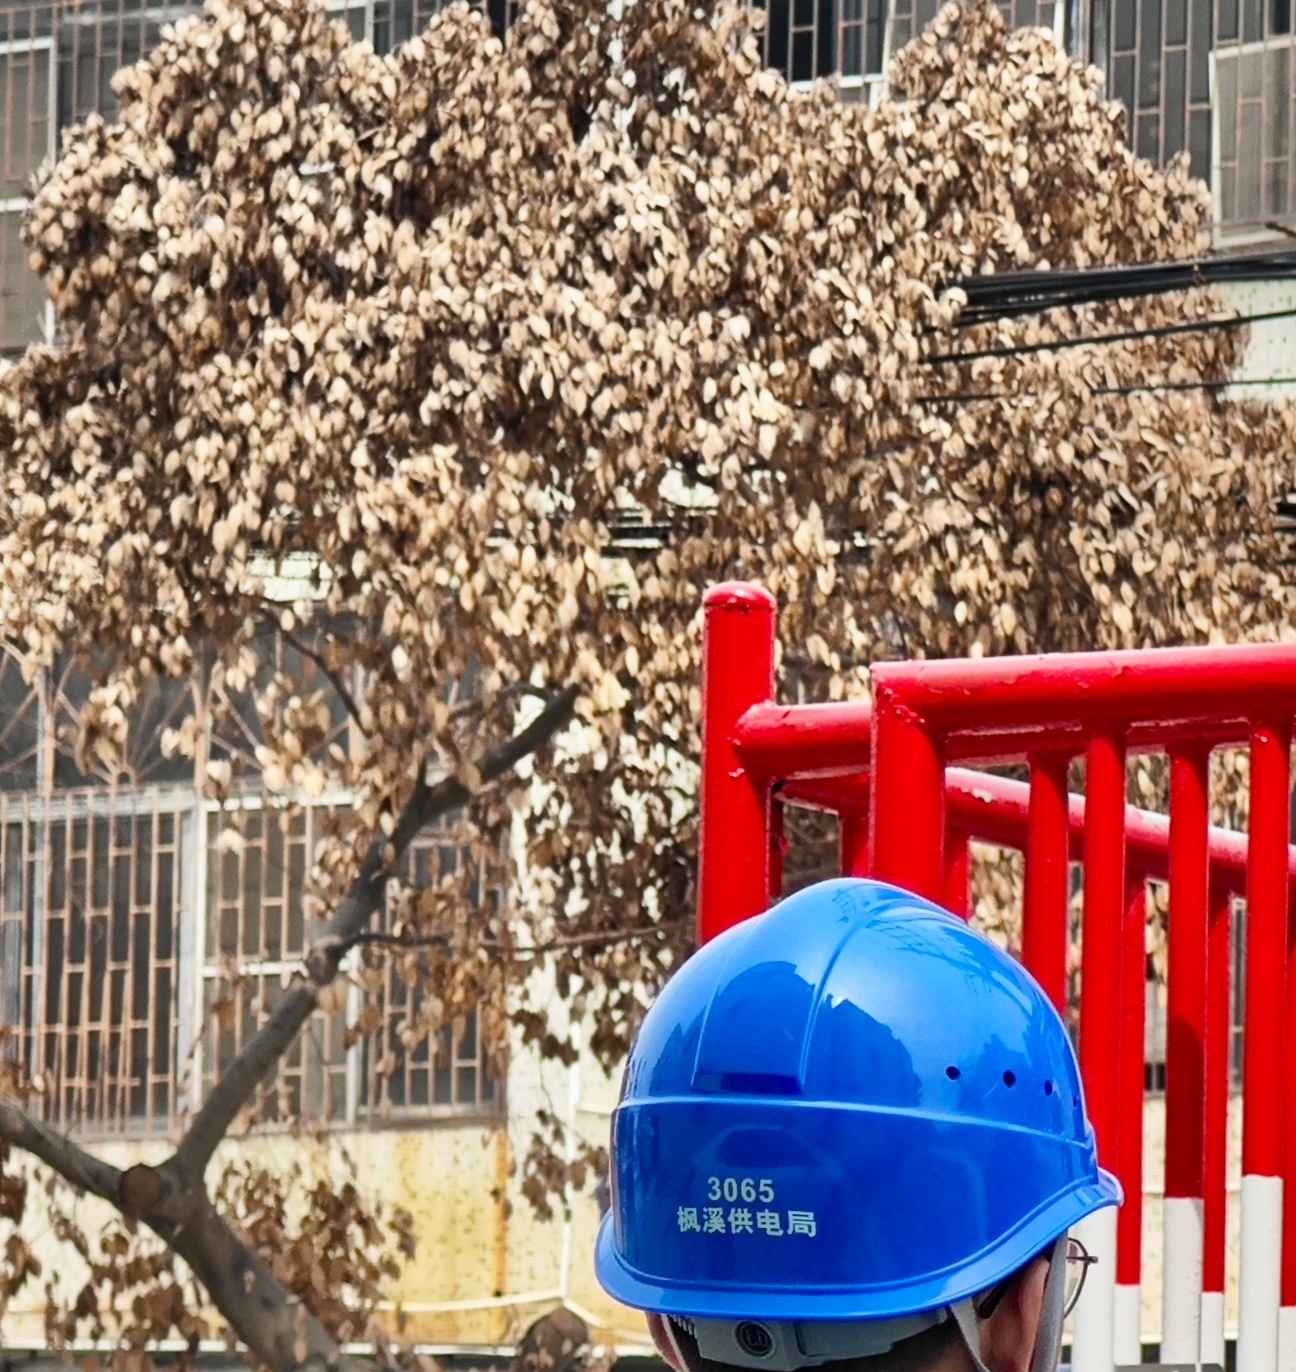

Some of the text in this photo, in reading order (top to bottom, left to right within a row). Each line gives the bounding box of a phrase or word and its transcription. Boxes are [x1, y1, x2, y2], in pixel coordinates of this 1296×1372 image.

[707, 1176, 776, 1203] 3065
[676, 1205, 818, 1238] 枫溪供电局
